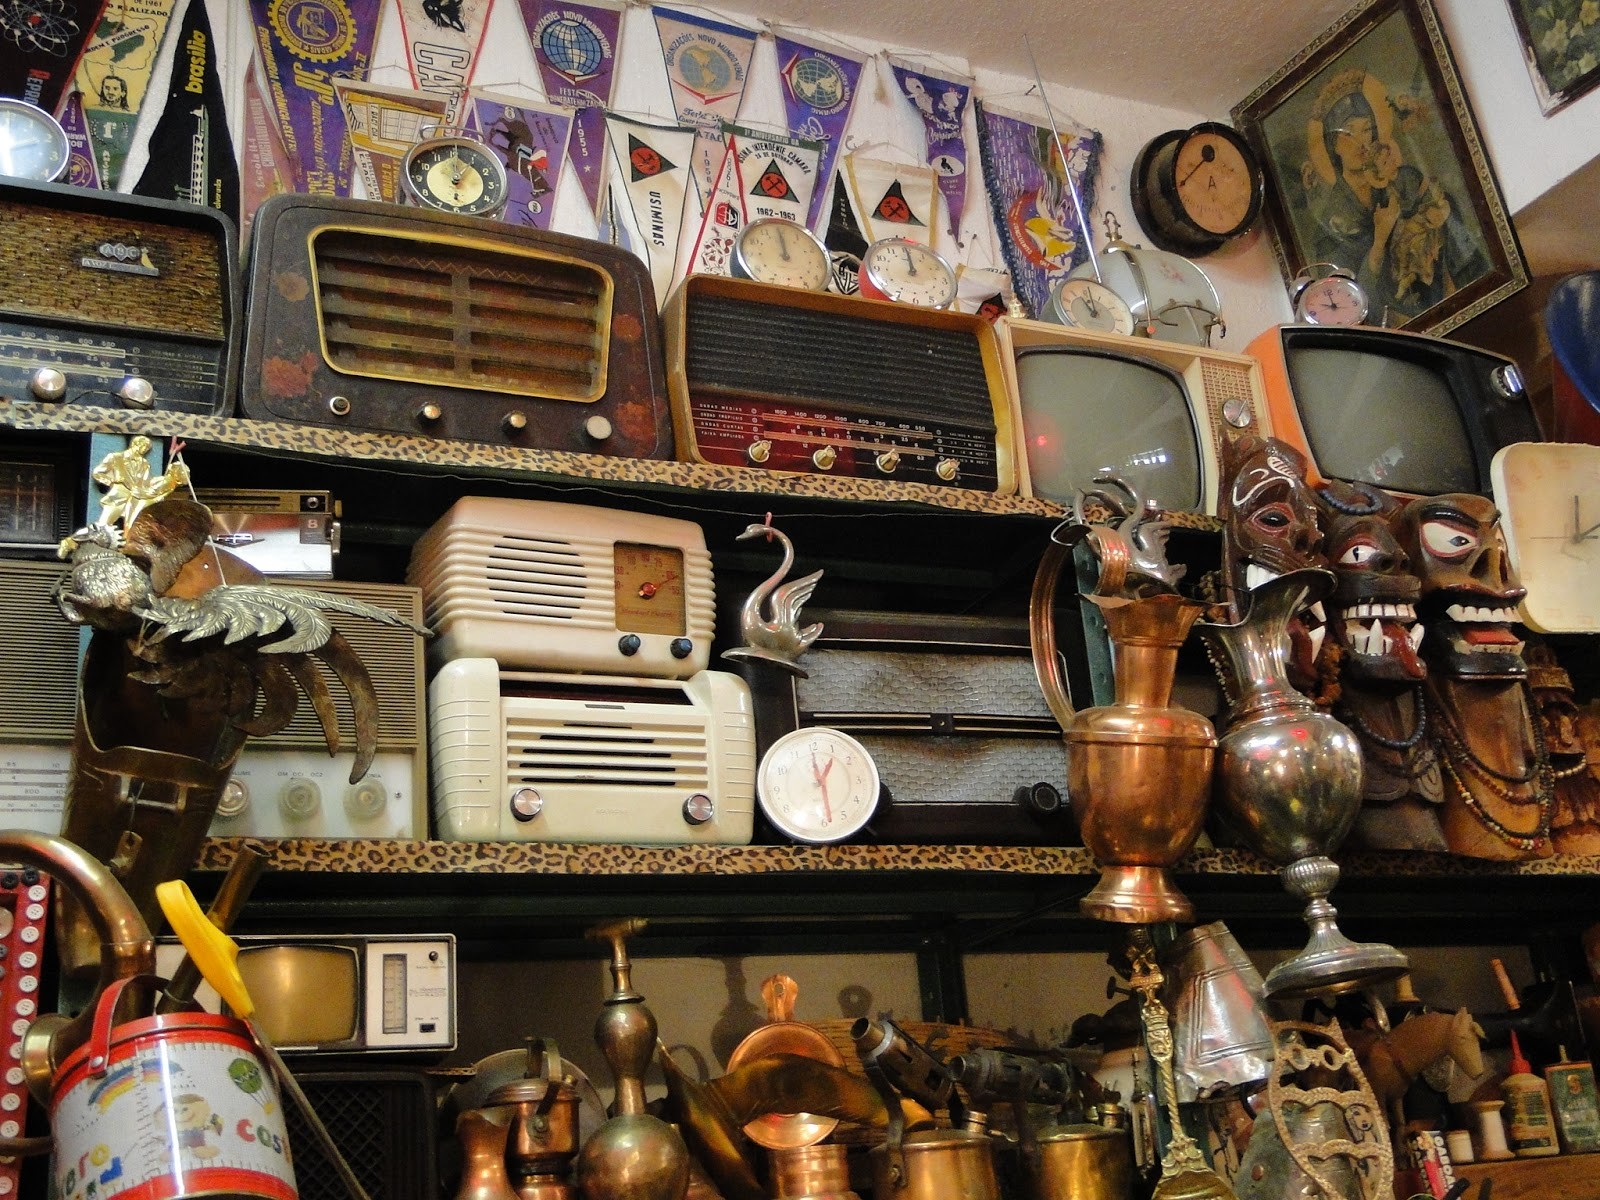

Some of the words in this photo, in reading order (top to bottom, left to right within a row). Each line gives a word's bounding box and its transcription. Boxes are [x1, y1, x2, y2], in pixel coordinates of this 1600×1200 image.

[697, 33, 717, 45] NOVO
[184, 30, 207, 94] brasilia
[577, 118, 589, 157] 1955
[751, 142, 786, 156] INTENDENTE
[421, 162, 431, 171] 10
[1207, 175, 1217, 191] A
[648, 190, 665, 247] USIMINAS
[756, 206, 796, 221] 1962-1963
[102, 243, 138, 259] ABC
[876, 254, 887, 262] 10
